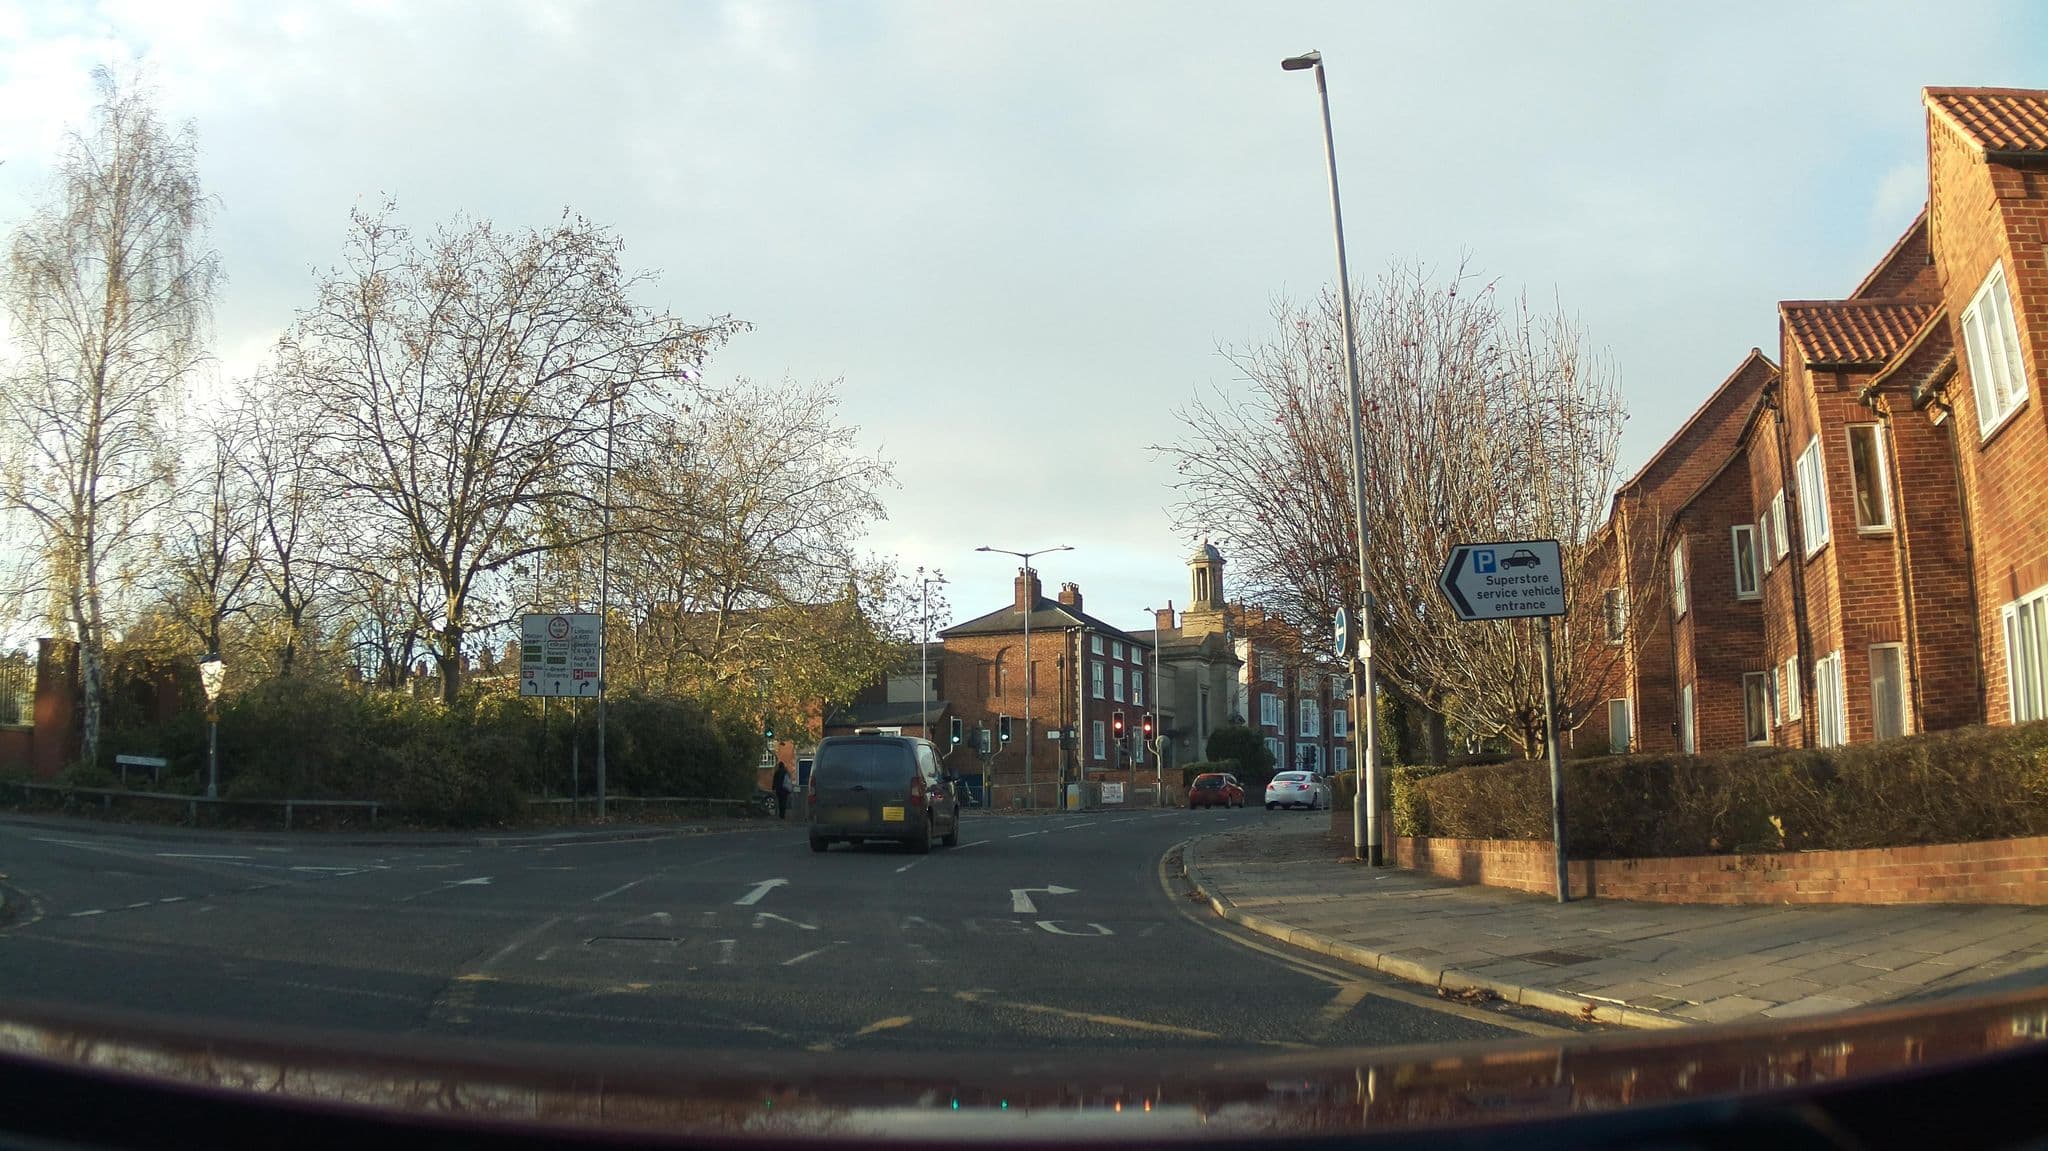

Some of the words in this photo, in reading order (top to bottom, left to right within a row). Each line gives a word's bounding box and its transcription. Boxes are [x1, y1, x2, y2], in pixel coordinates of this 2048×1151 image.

[1478, 551, 1492, 572] P
[1486, 574, 1549, 587] Superstore
[1476, 588, 1518, 600] service
[1522, 585, 1561, 597] vehicle
[1495, 601, 1546, 612] entrance
